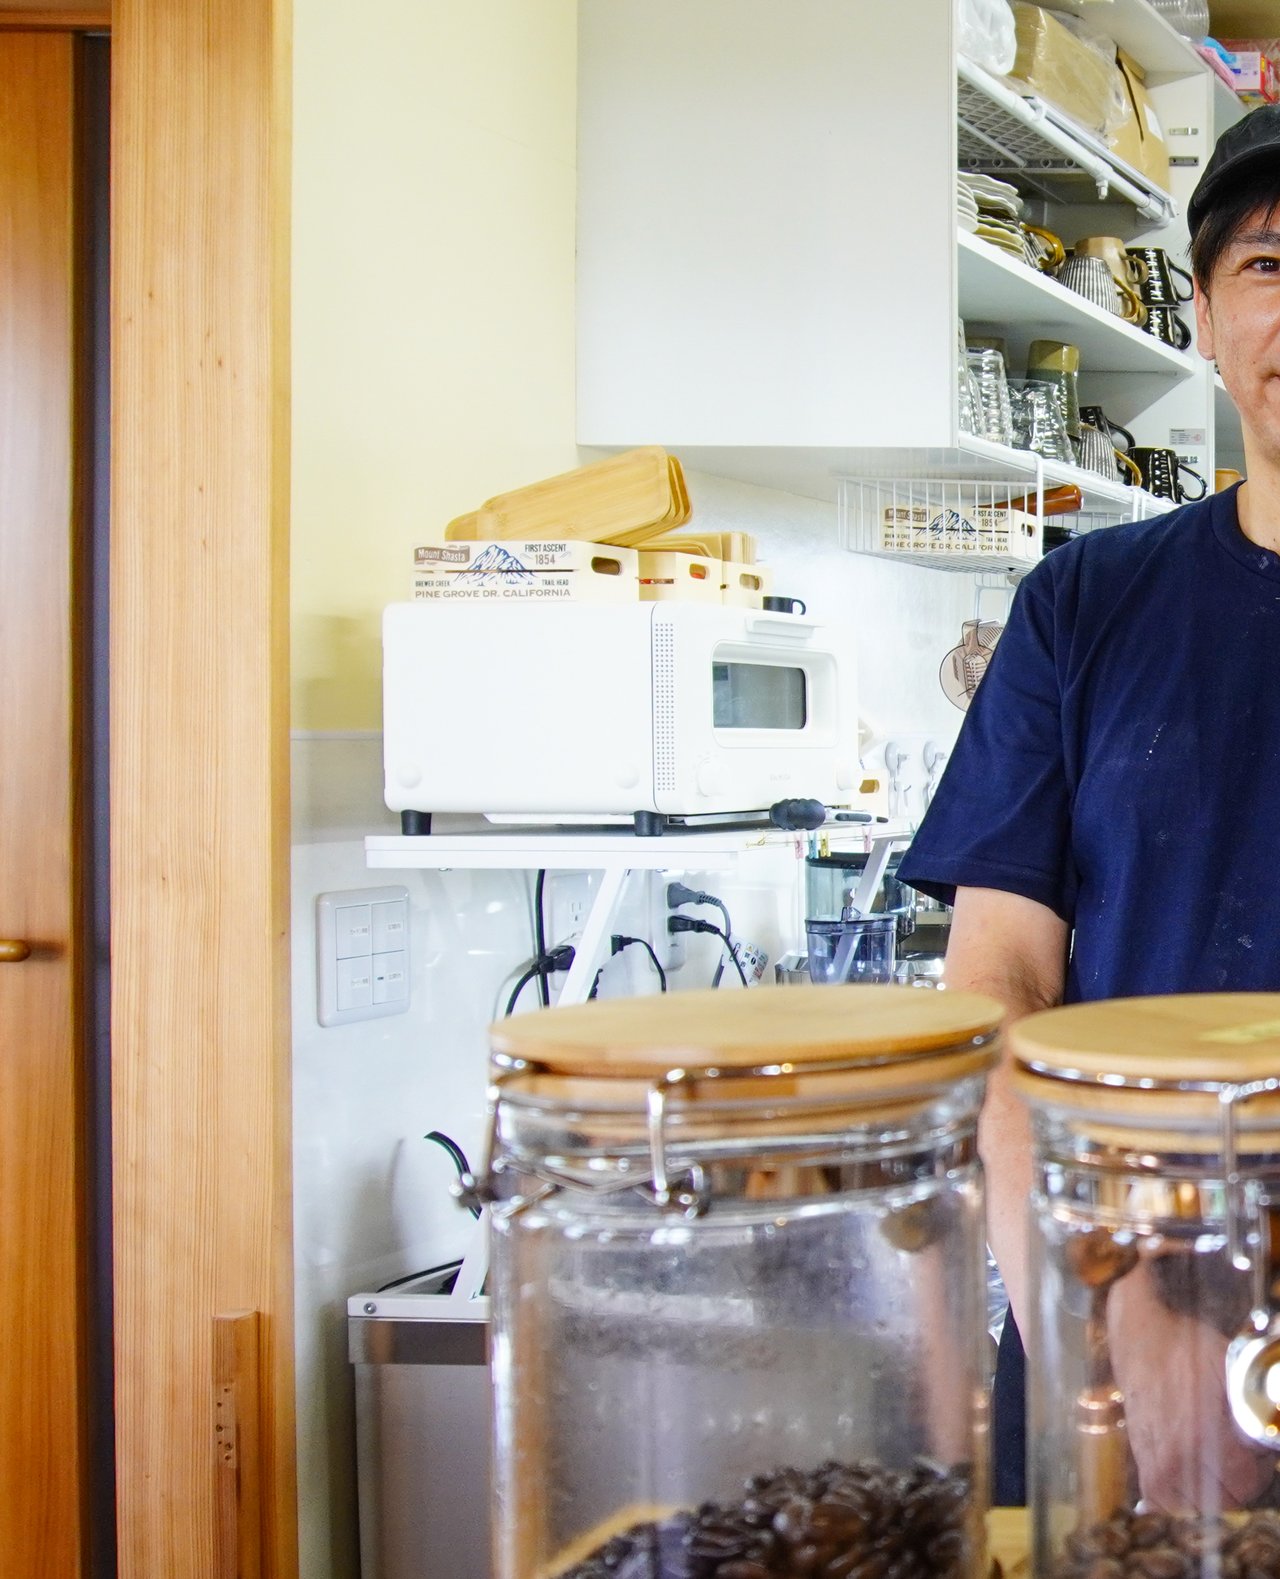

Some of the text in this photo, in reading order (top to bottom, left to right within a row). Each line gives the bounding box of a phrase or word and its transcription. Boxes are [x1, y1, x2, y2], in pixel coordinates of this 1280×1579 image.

[525, 544, 567, 552] FIRST ASCENT
[418, 549, 466, 562] Mount Shasta
[535, 554, 556, 565] 1854
[415, 588, 571, 599] PINE GROVE DR. CALIFORNIA
